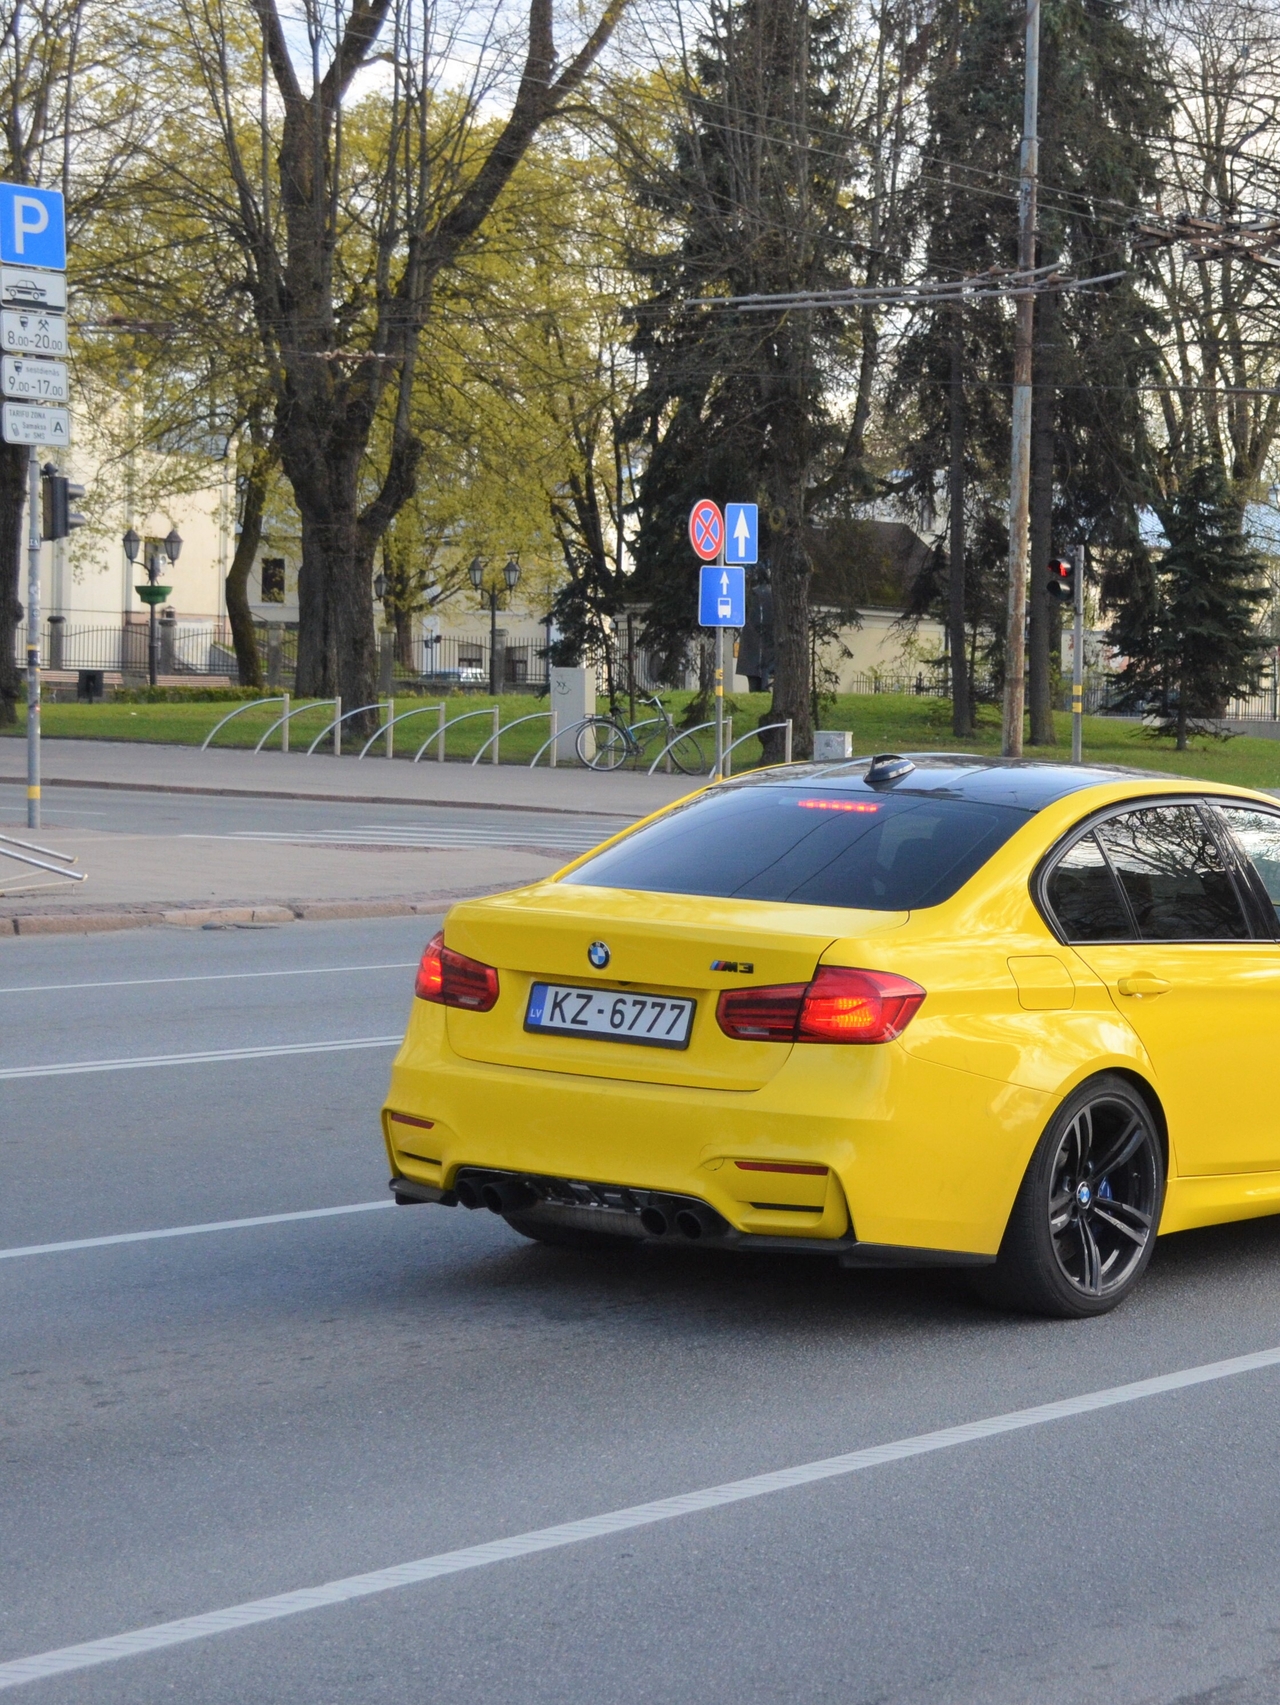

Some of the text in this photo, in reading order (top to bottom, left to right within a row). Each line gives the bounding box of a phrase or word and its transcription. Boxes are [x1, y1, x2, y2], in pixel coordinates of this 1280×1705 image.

[14, 195, 48, 255] P
[53, 421, 64, 433] A
[530, 990, 686, 1036] LV KZ-6777
